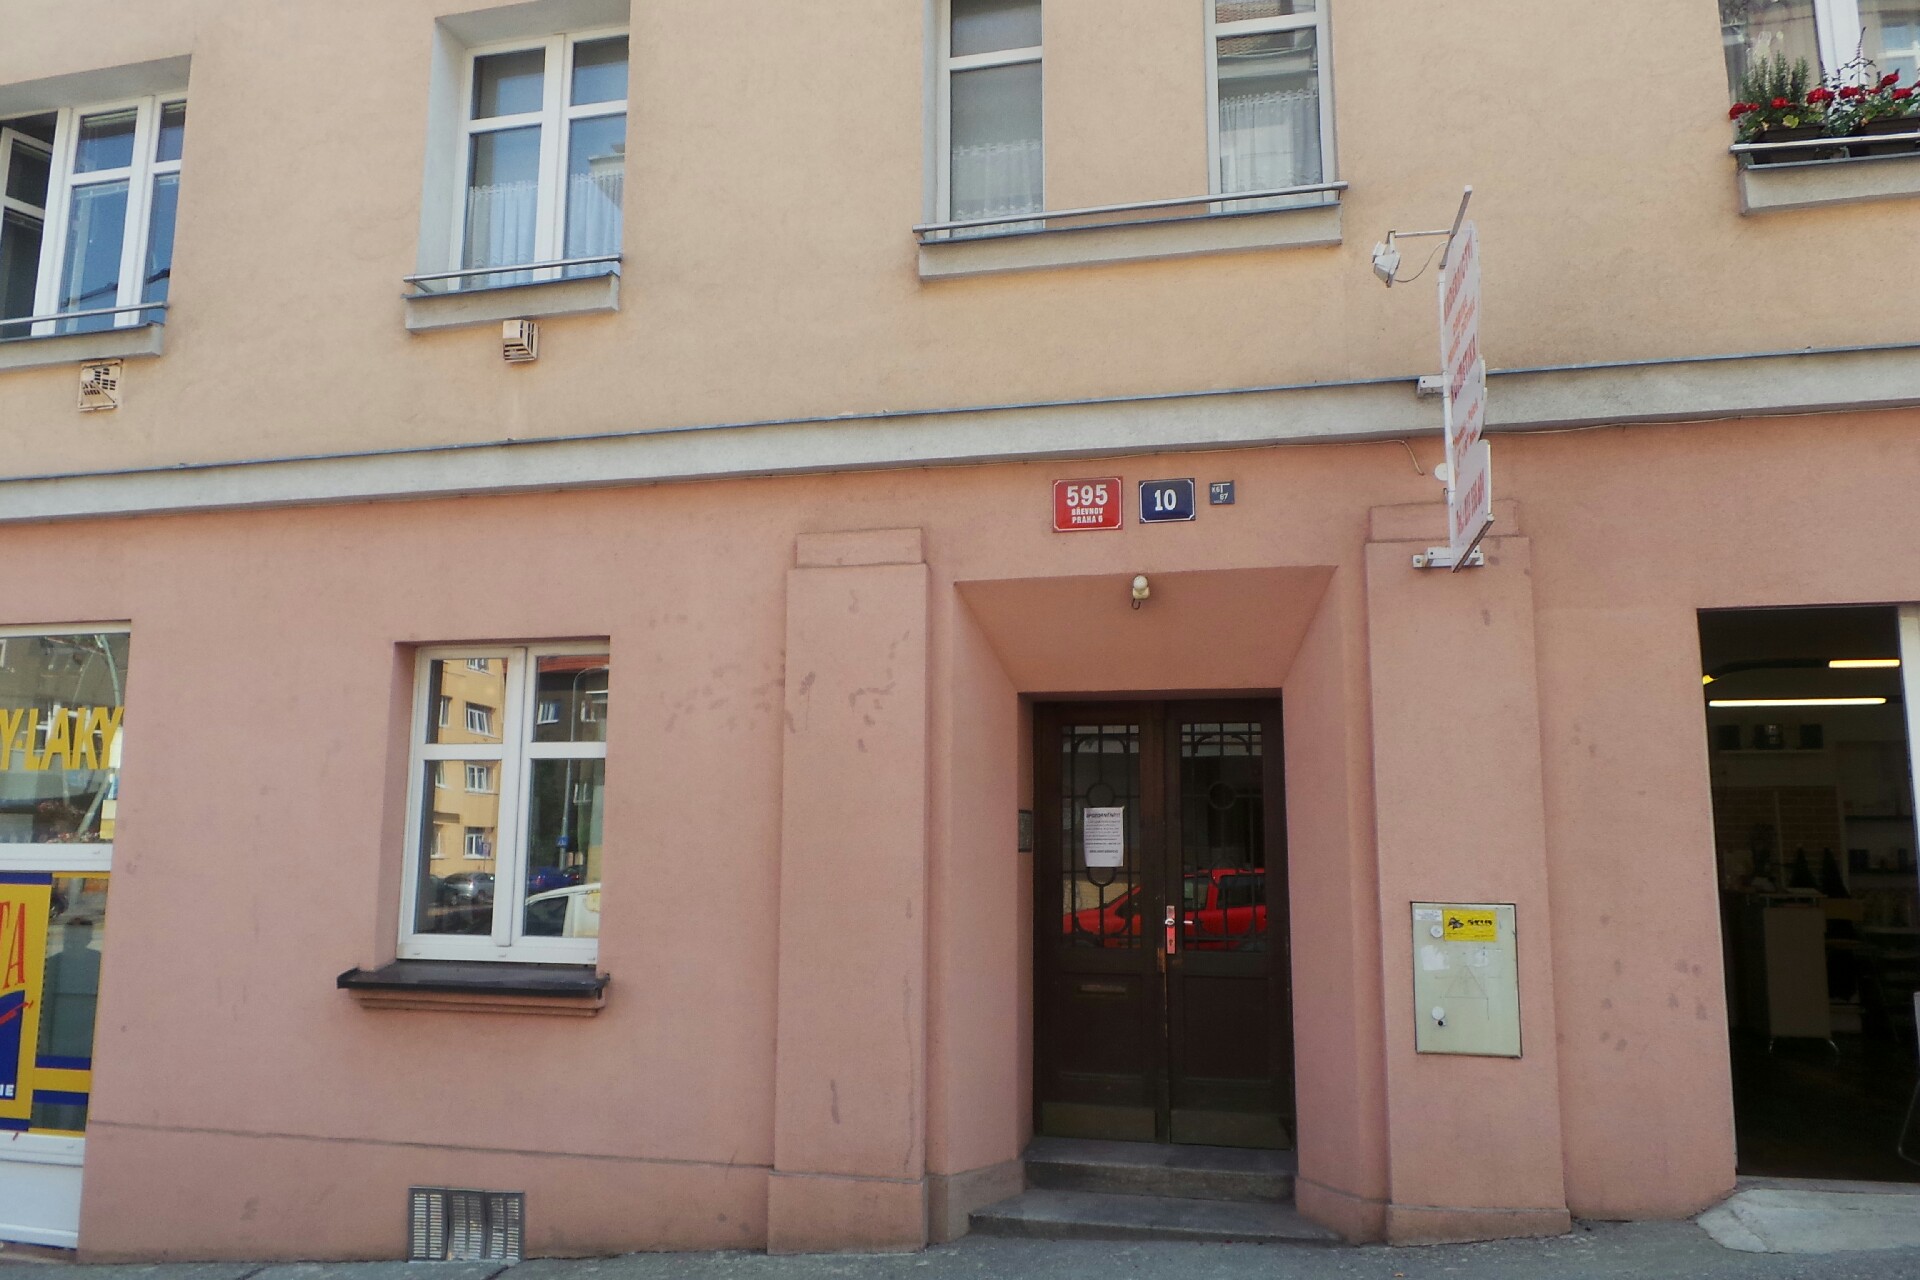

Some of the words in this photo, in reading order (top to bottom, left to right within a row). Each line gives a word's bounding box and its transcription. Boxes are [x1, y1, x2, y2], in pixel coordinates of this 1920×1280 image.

[1066, 484, 1108, 507] 595
[1154, 489, 1177, 511] 10
[1071, 507, 1104, 516] BŘEVNOV
[1072, 516, 1097, 524] PRAHA
[1098, 515, 1103, 523] 6
